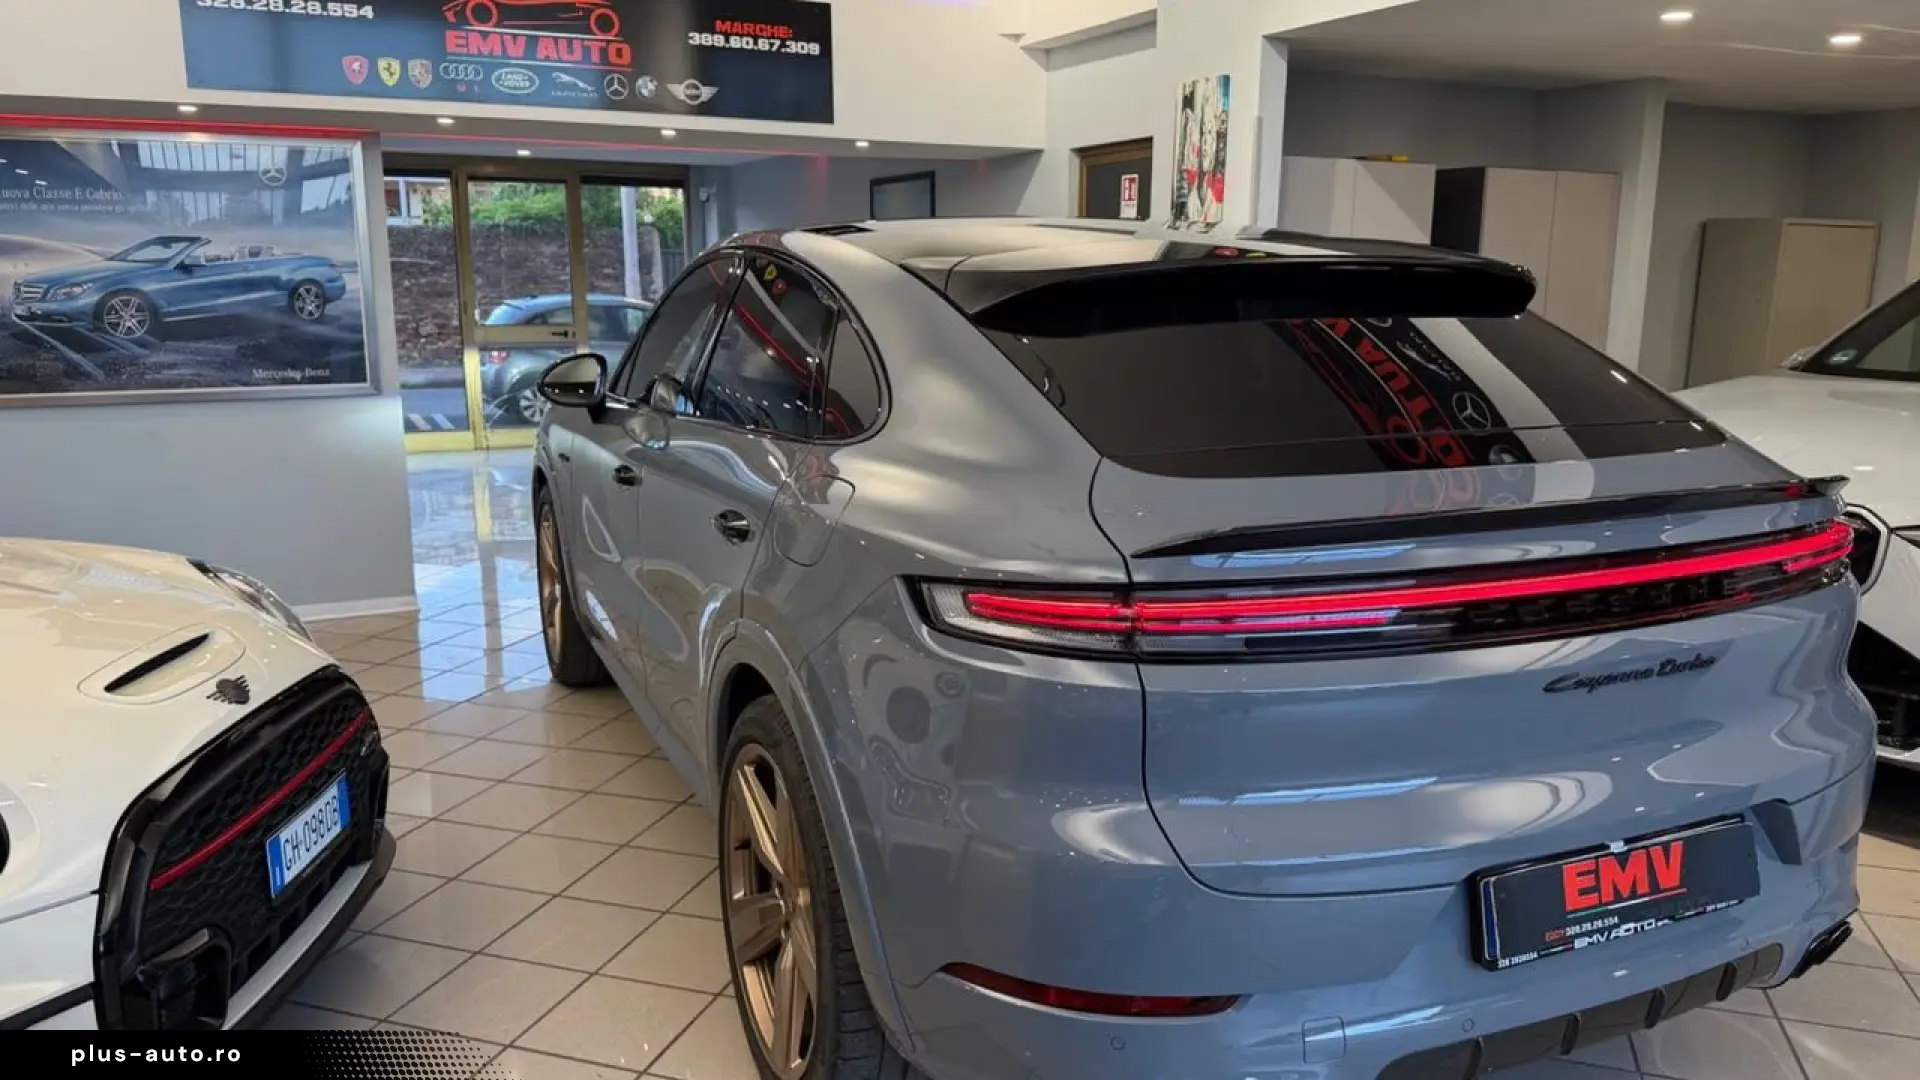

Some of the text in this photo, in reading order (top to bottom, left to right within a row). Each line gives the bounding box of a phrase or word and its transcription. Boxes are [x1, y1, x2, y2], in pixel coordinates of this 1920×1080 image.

[715, 20, 793, 38] MARCHE:
[445, 30, 632, 66] EMV AUTO
[688, 33, 821, 56] 389.60.67.309
[1, 189, 29, 199] uova
[33, 187, 73, 200] Classe
[1542, 667, 1656, 694] Cayenne
[1562, 840, 1684, 912] EMV
[1574, 931, 1608, 949] EMV
[1610, 917, 1656, 941] AUTO
